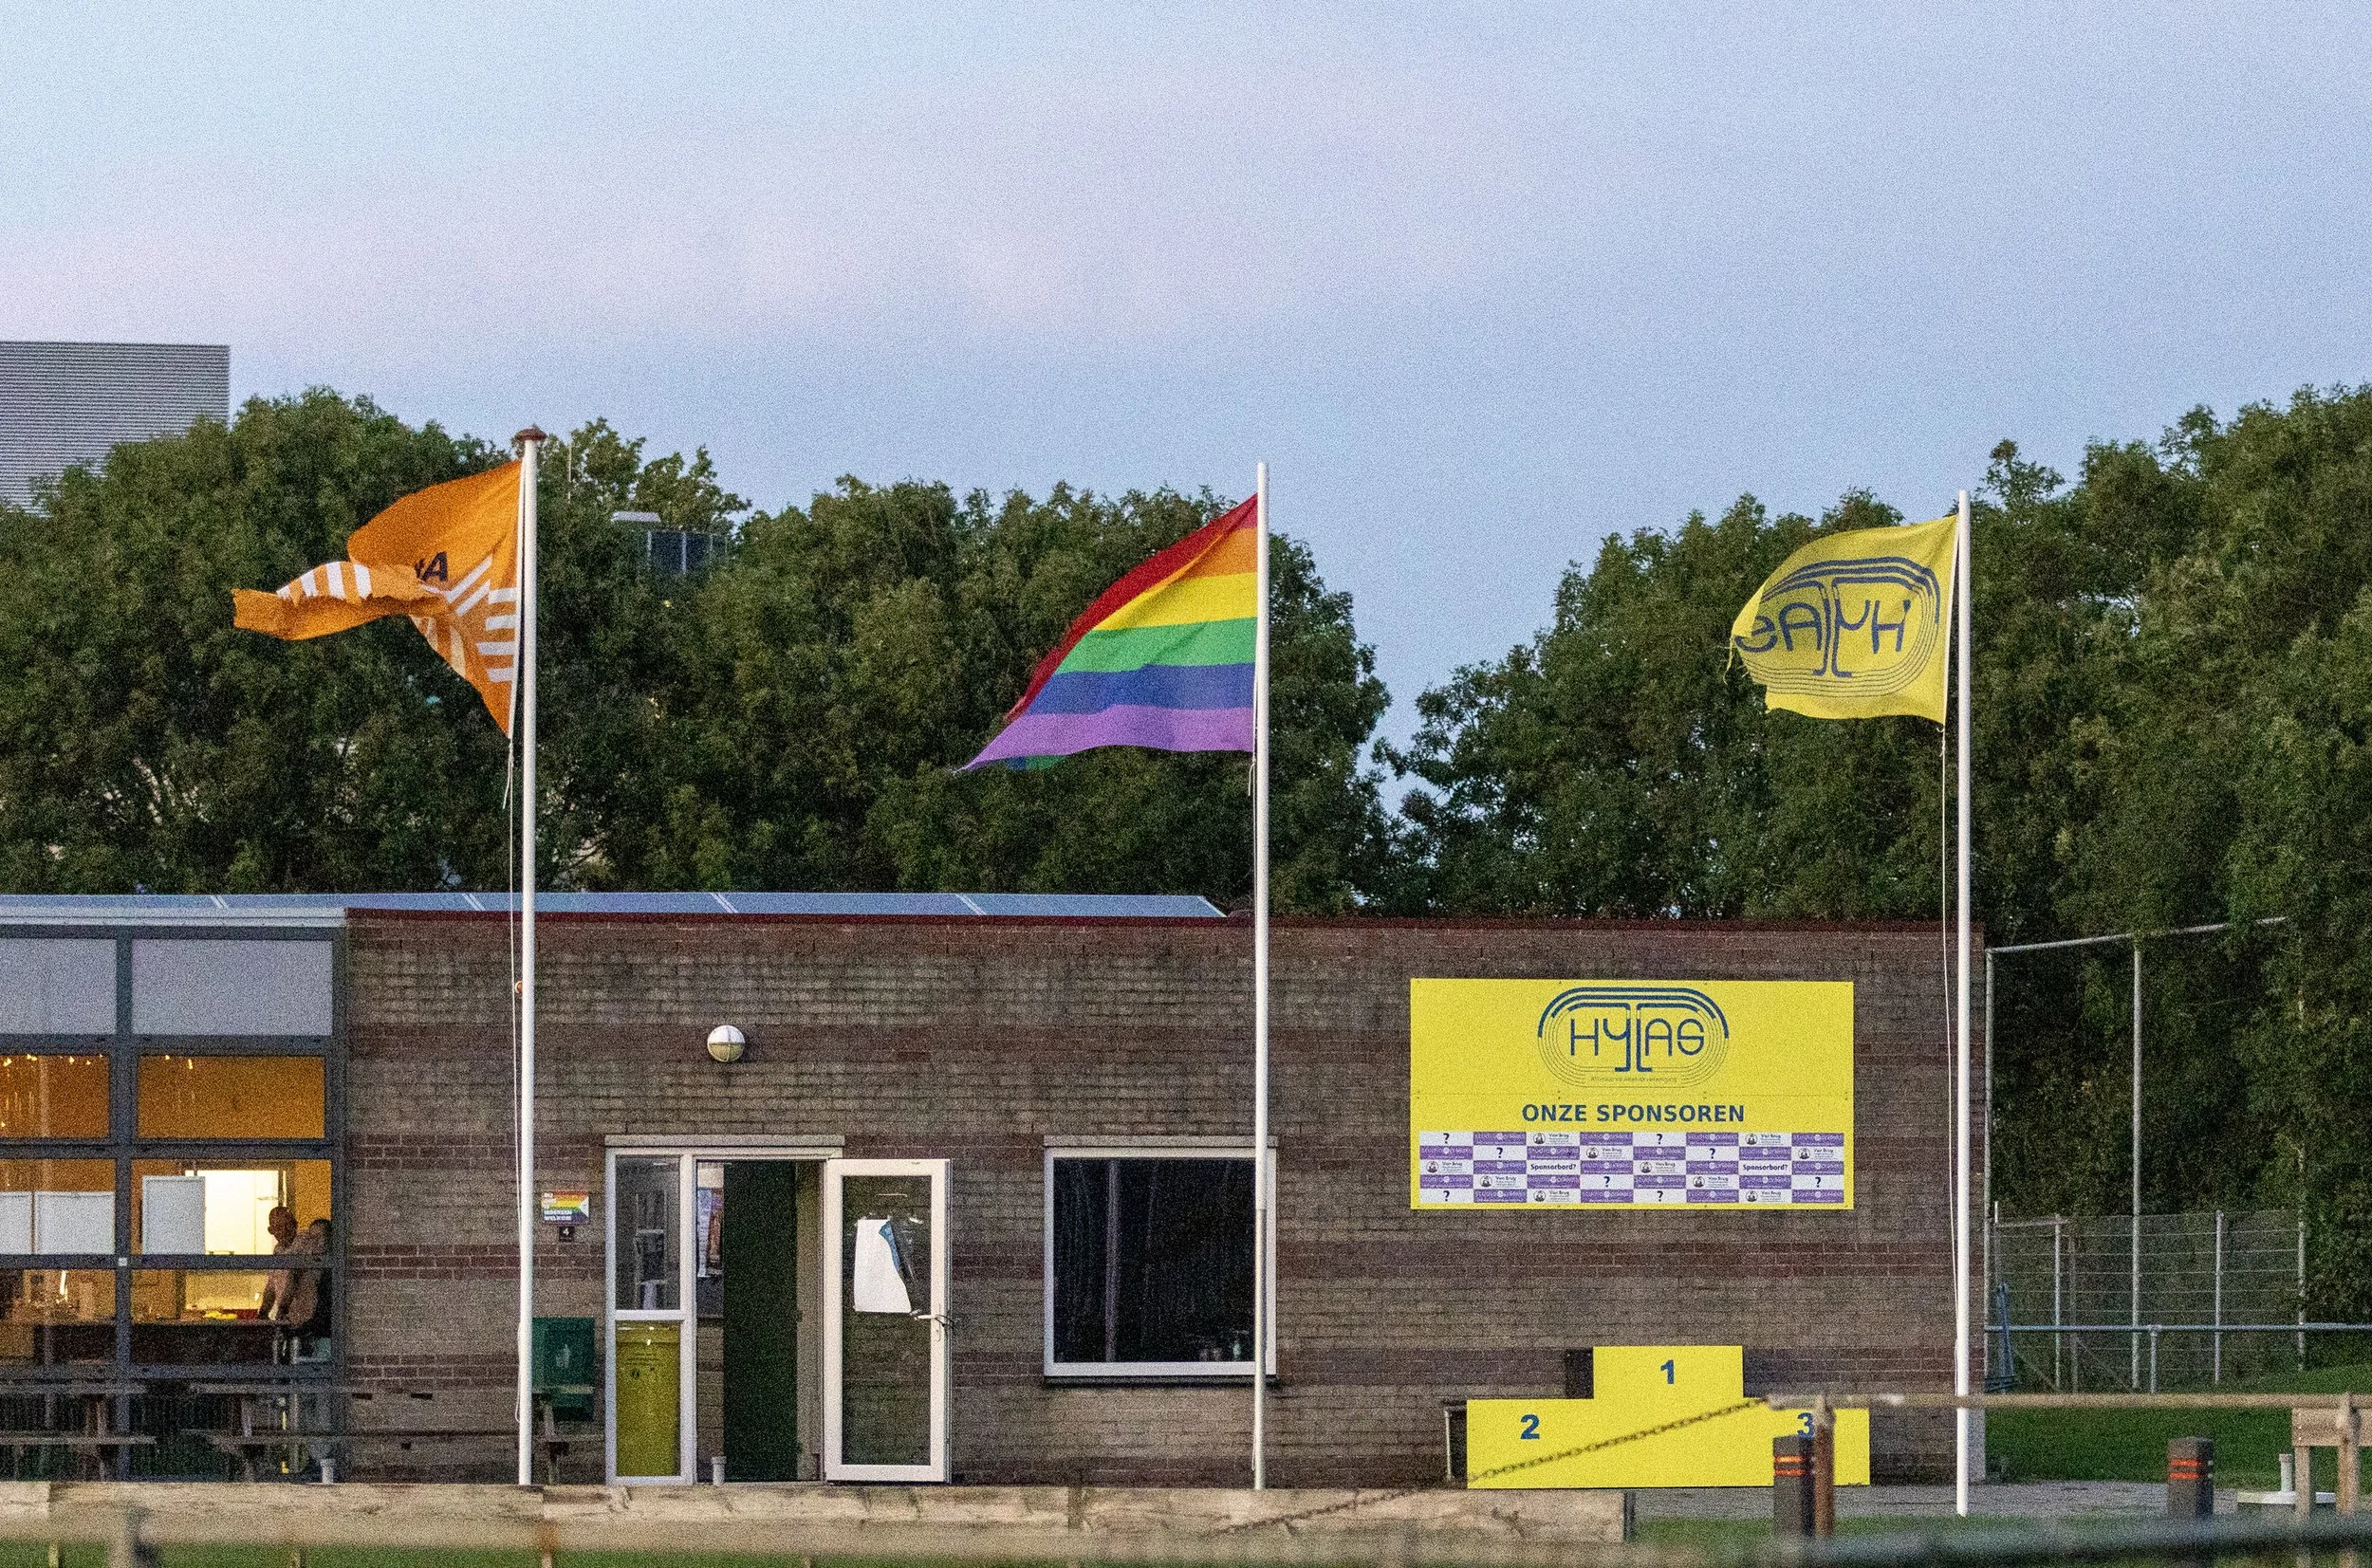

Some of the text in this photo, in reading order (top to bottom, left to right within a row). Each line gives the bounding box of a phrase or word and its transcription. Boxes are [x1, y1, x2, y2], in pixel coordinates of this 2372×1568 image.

[1569, 1017, 1705, 1072] HYLAS
[1521, 1103, 1745, 1123] ONZE SPONSOREN
[1443, 1133, 1450, 1144] ?
[1657, 1134, 1663, 1145] ?
[1496, 1147, 1503, 1158] ?
[1709, 1148, 1715, 1159] ?
[1603, 1176, 1610, 1188] ?
[1815, 1176, 1822, 1188] ?
[1443, 1190, 1451, 1202] ?
[1657, 1190, 1663, 1202] ?
[563, 1227, 569, 1236] 4
[1660, 1359, 1675, 1385] 1
[1520, 1413, 1540, 1440] 2
[1797, 1412, 1815, 1439] 3
